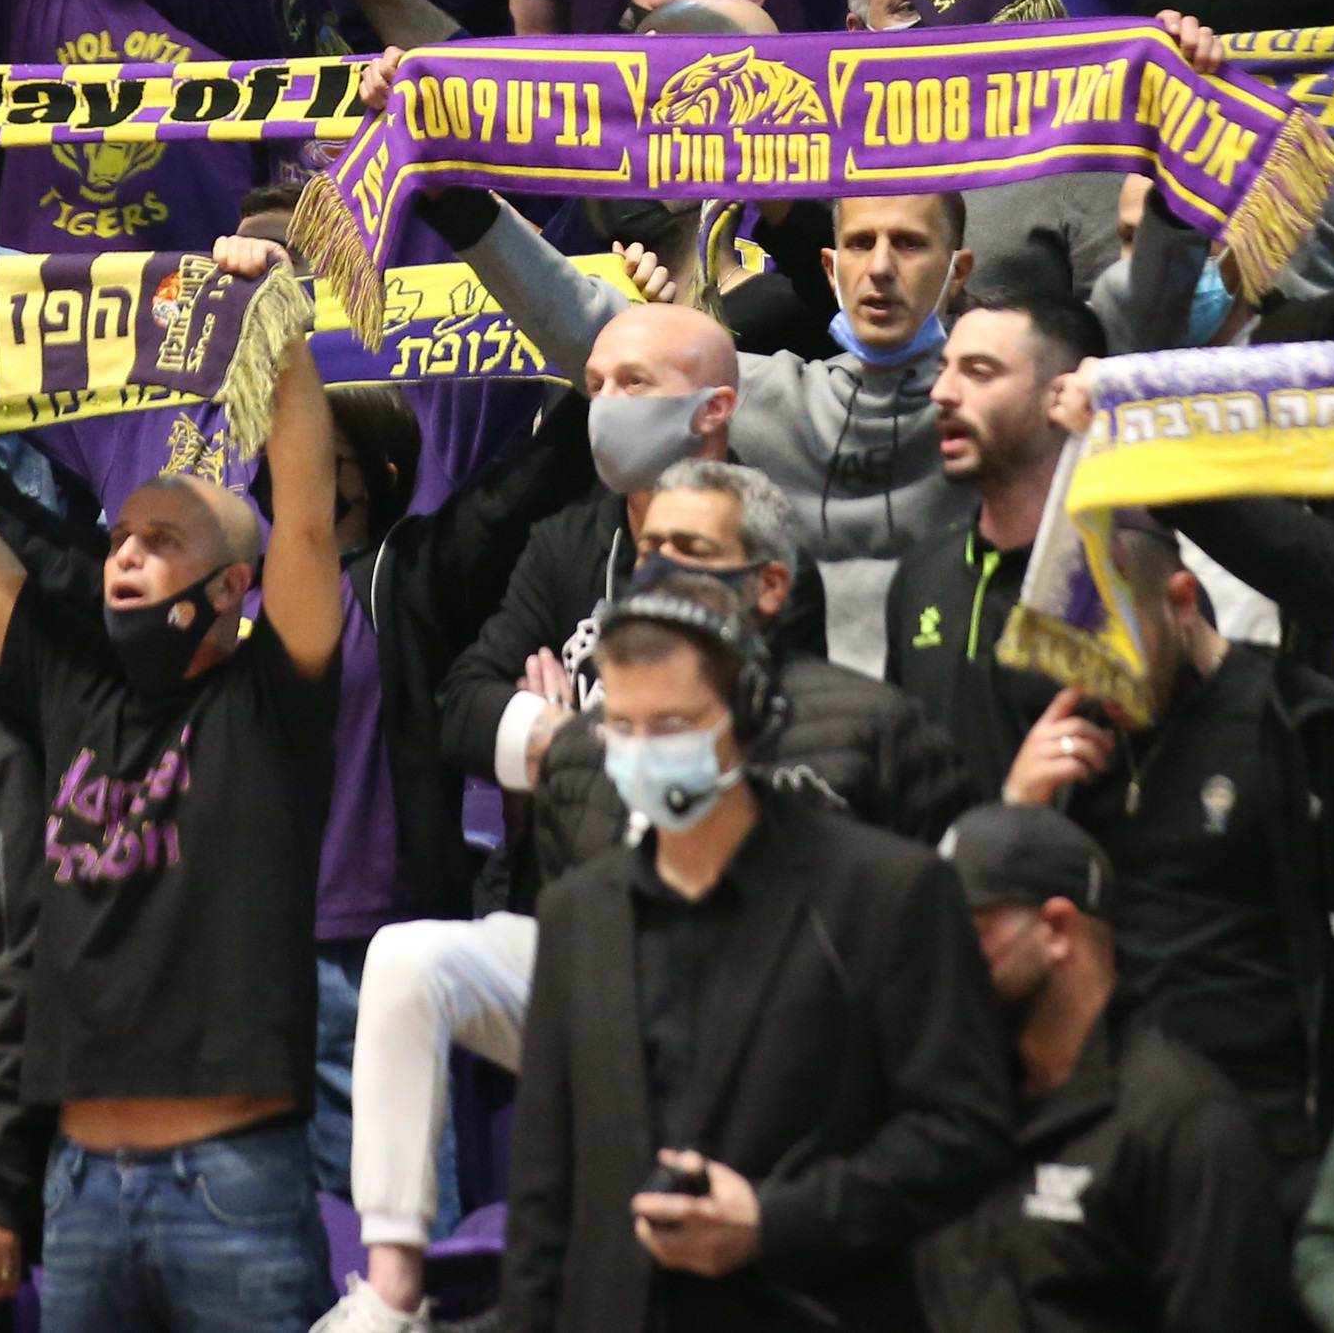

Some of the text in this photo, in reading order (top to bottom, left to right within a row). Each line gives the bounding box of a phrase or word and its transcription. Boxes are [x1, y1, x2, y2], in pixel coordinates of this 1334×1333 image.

[169, 68, 291, 122] of
[395, 76, 602, 148] גביע 2009
[863, 75, 969, 147] 2008
[984, 57, 1131, 136] המדינה
[647, 130, 830, 186] הפועל חולון
[37, 185, 170, 239] TIGERS
[186, 312, 216, 376] Since
[389, 316, 547, 377] אלופת
